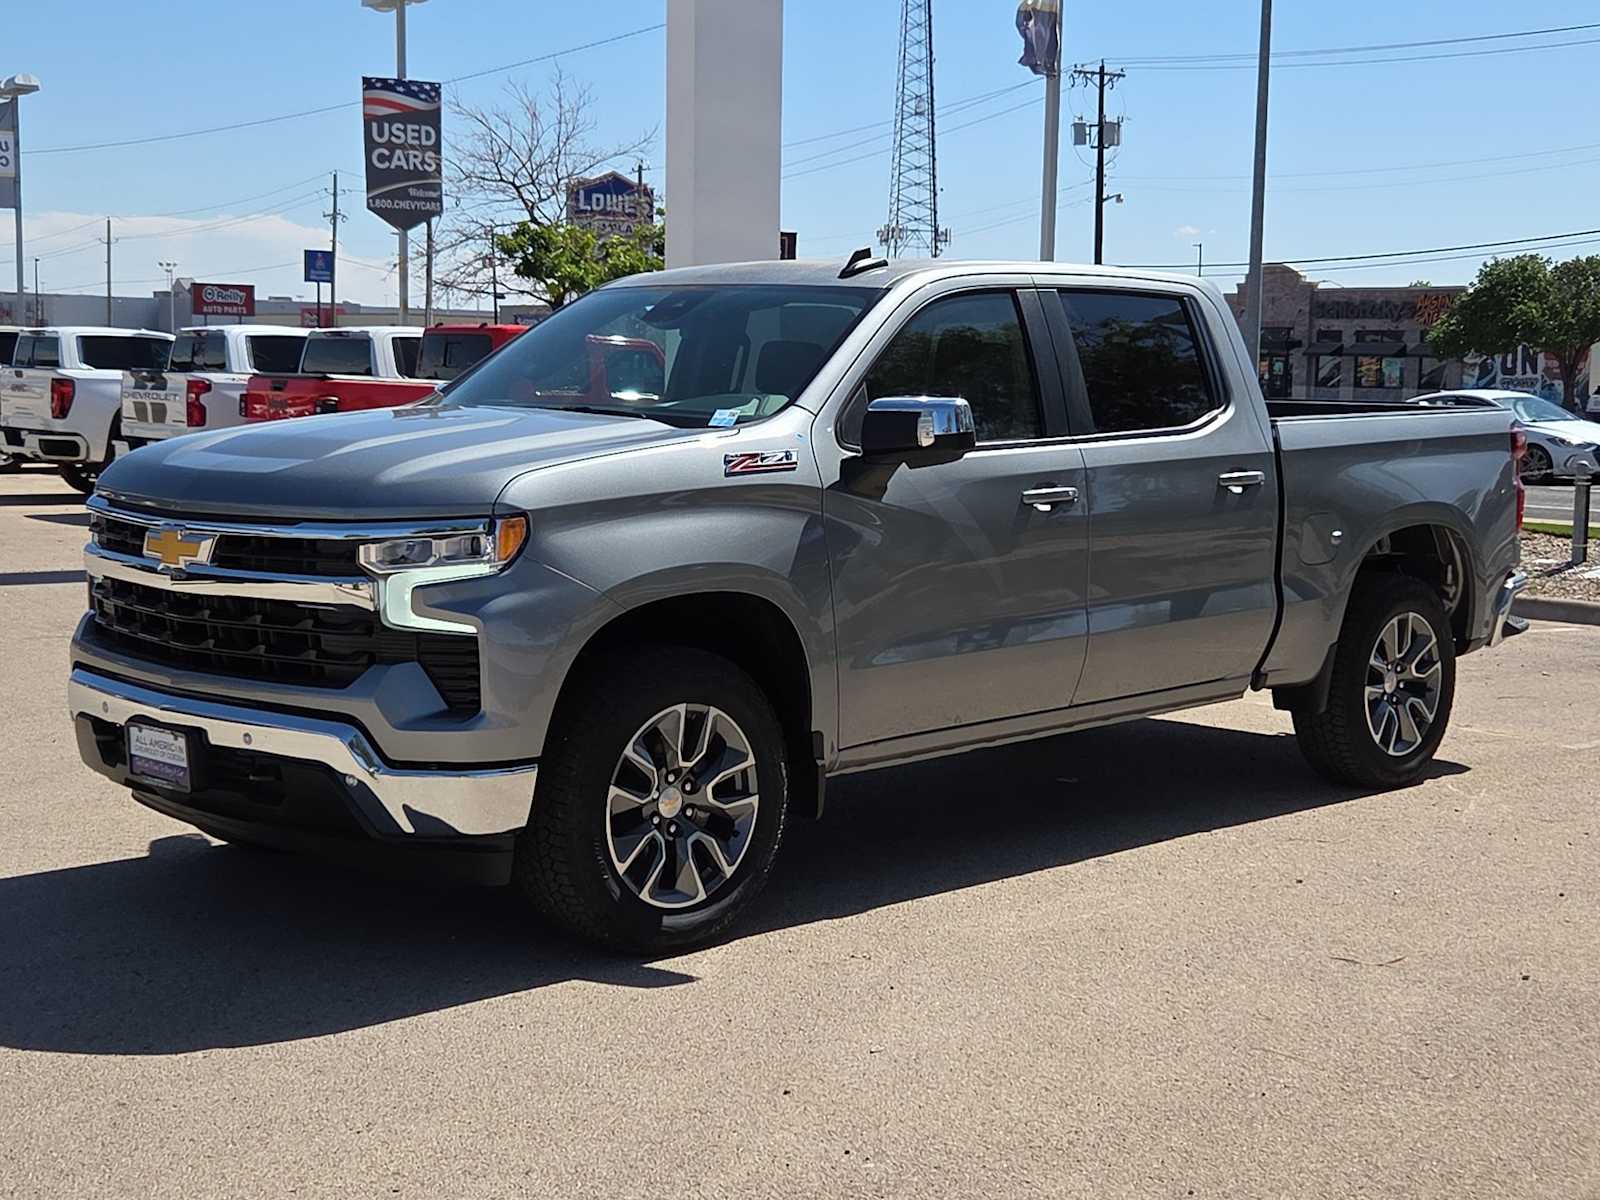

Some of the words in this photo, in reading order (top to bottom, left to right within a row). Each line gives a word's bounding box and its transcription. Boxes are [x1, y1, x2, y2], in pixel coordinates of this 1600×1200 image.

[371, 122, 436, 146] USED
[371, 148, 436, 172] CARS
[202, 286, 246, 304] O'Reilly
[203, 304, 222, 313] AUTO
[223, 305, 247, 314] PARTS
[122, 391, 180, 400] CHEVROLET
[135, 735, 148, 746] ALL
